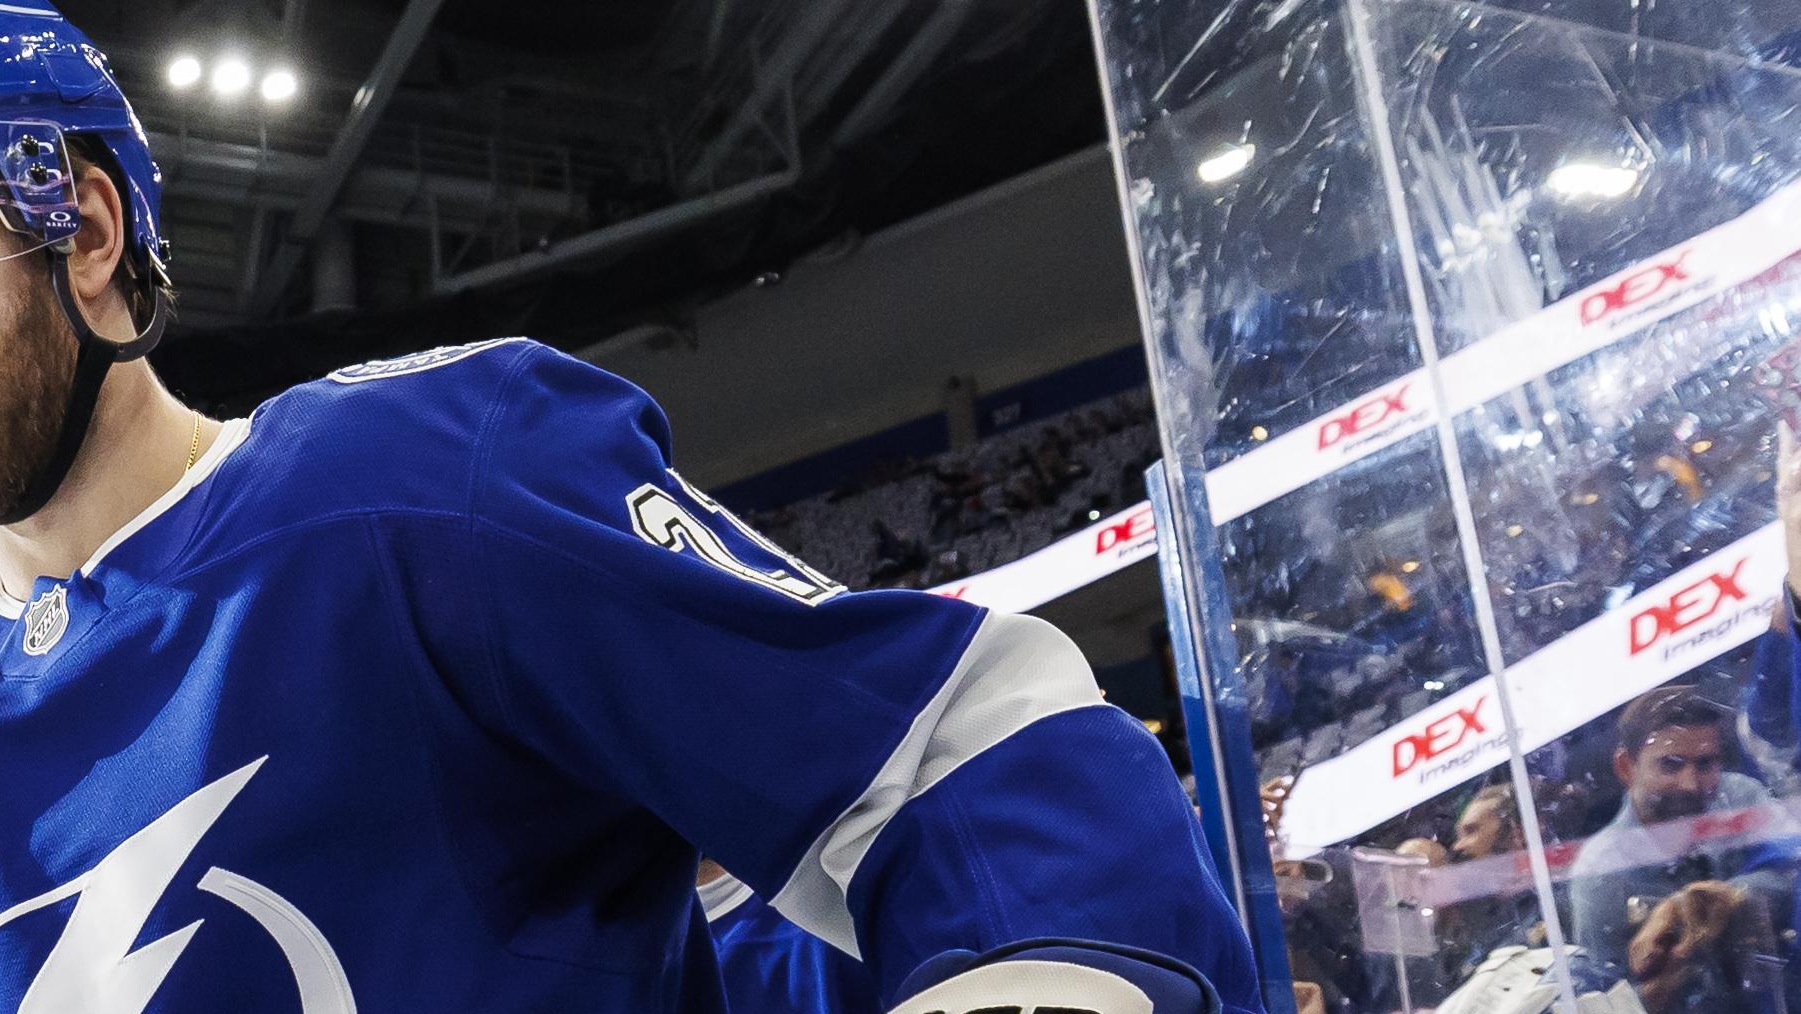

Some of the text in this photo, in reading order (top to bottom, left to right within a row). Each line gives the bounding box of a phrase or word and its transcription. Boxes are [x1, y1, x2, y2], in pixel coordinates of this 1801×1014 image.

[1580, 250, 1694, 327] DEX
[1317, 383, 1412, 451] DEX
[1096, 507, 1157, 555] DE
[33, 602, 61, 647] NHL
[1629, 556, 1750, 655] DEX
[1393, 694, 1489, 777] DEX
